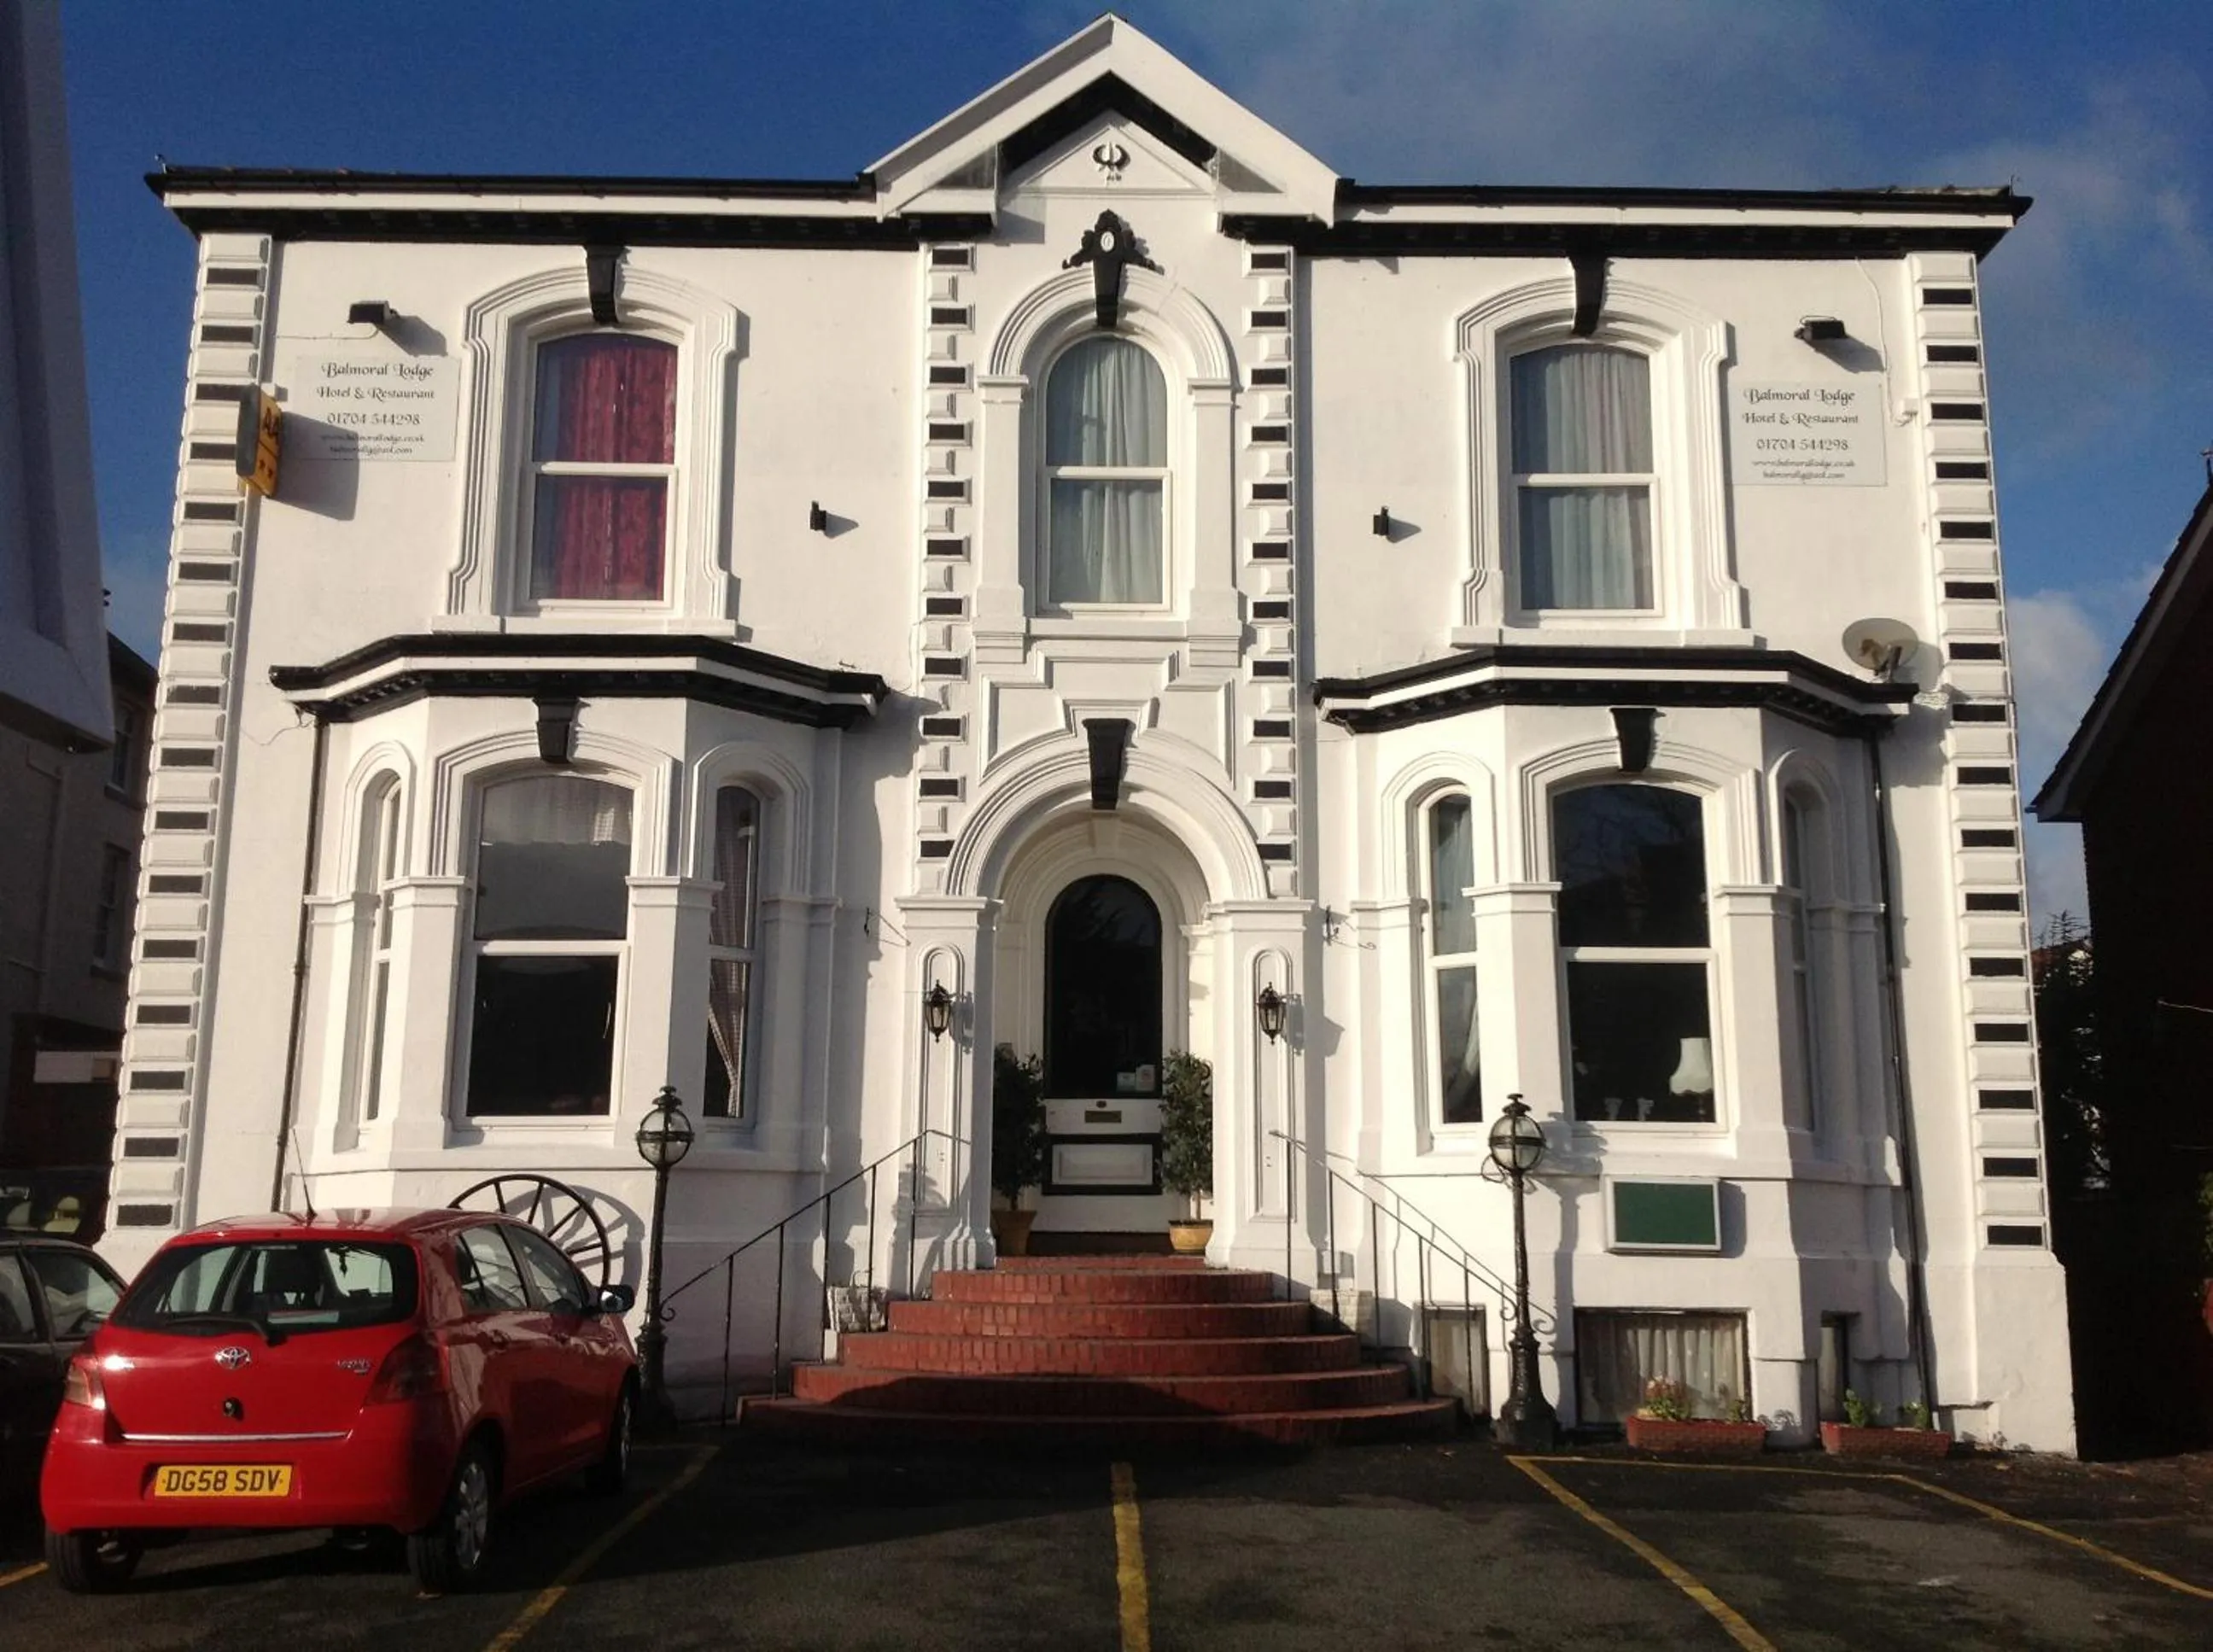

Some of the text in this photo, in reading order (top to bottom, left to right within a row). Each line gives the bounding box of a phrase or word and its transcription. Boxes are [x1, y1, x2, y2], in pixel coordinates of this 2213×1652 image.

[321, 362, 434, 381] Balmoral Lodge
[317, 386, 435, 402] Hotel & Restaurant
[1743, 388, 1855, 406] Balmoral Lodge
[327, 412, 421, 426] 01704 544298
[1743, 412, 1859, 429] Hotel & Restaurant
[1756, 439, 1848, 451] 01704 544298
[165, 1469, 282, 1493] DG58 SDV
